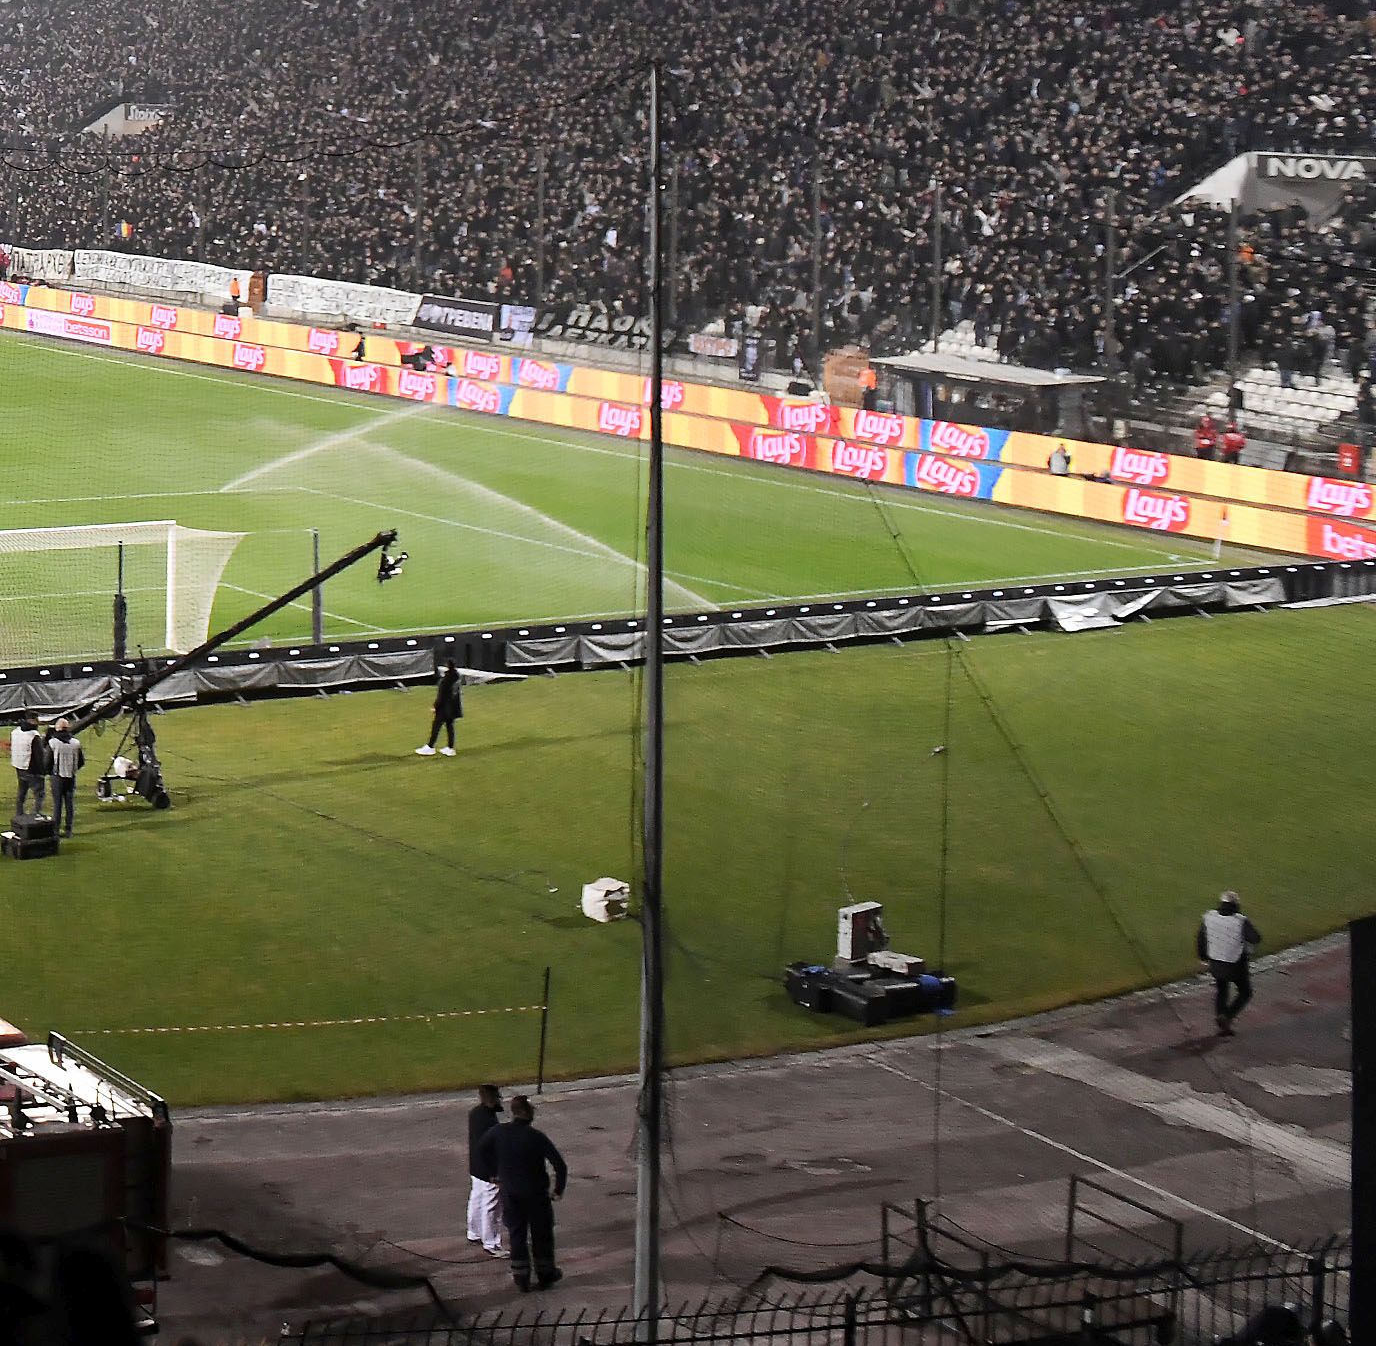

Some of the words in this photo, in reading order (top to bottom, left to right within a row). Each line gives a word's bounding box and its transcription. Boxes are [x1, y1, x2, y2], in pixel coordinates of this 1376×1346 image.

[1268, 157, 1366, 180] NOVA
[65, 320, 108, 340] betsson
[645, 377, 683, 409] Ly's
[600, 403, 640, 435] Lay's
[856, 410, 902, 444] Lay's
[932, 422, 983, 458] Lay's
[834, 441, 884, 477] Lay's
[919, 455, 975, 497] Lay's
[1112, 447, 1168, 484] Lay's
[1125, 489, 1188, 530] Lay's
[1308, 476, 1372, 516] Lay's
